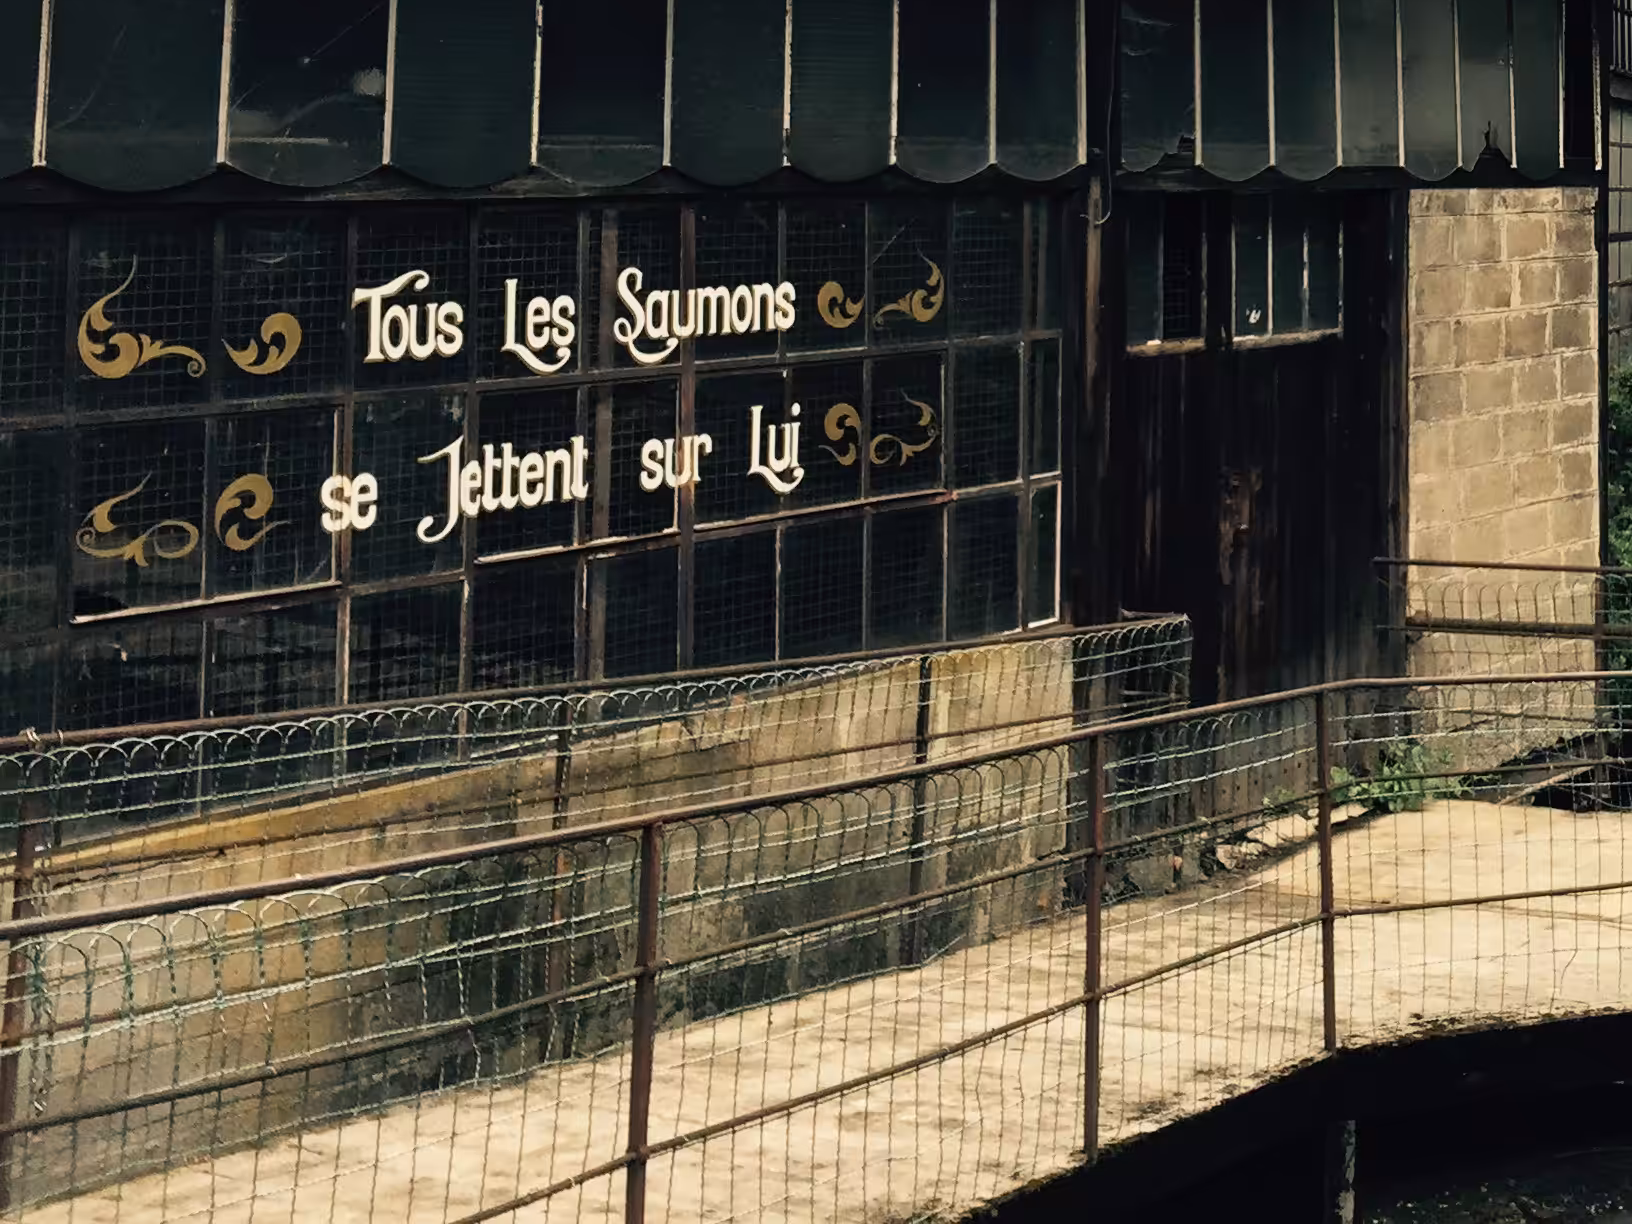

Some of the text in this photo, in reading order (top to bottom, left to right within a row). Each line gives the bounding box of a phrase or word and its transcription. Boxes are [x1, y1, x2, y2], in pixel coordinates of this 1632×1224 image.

[350, 266, 797, 374] Tous Les Saumons
[319, 402, 805, 544] se Jettent sur Lui
